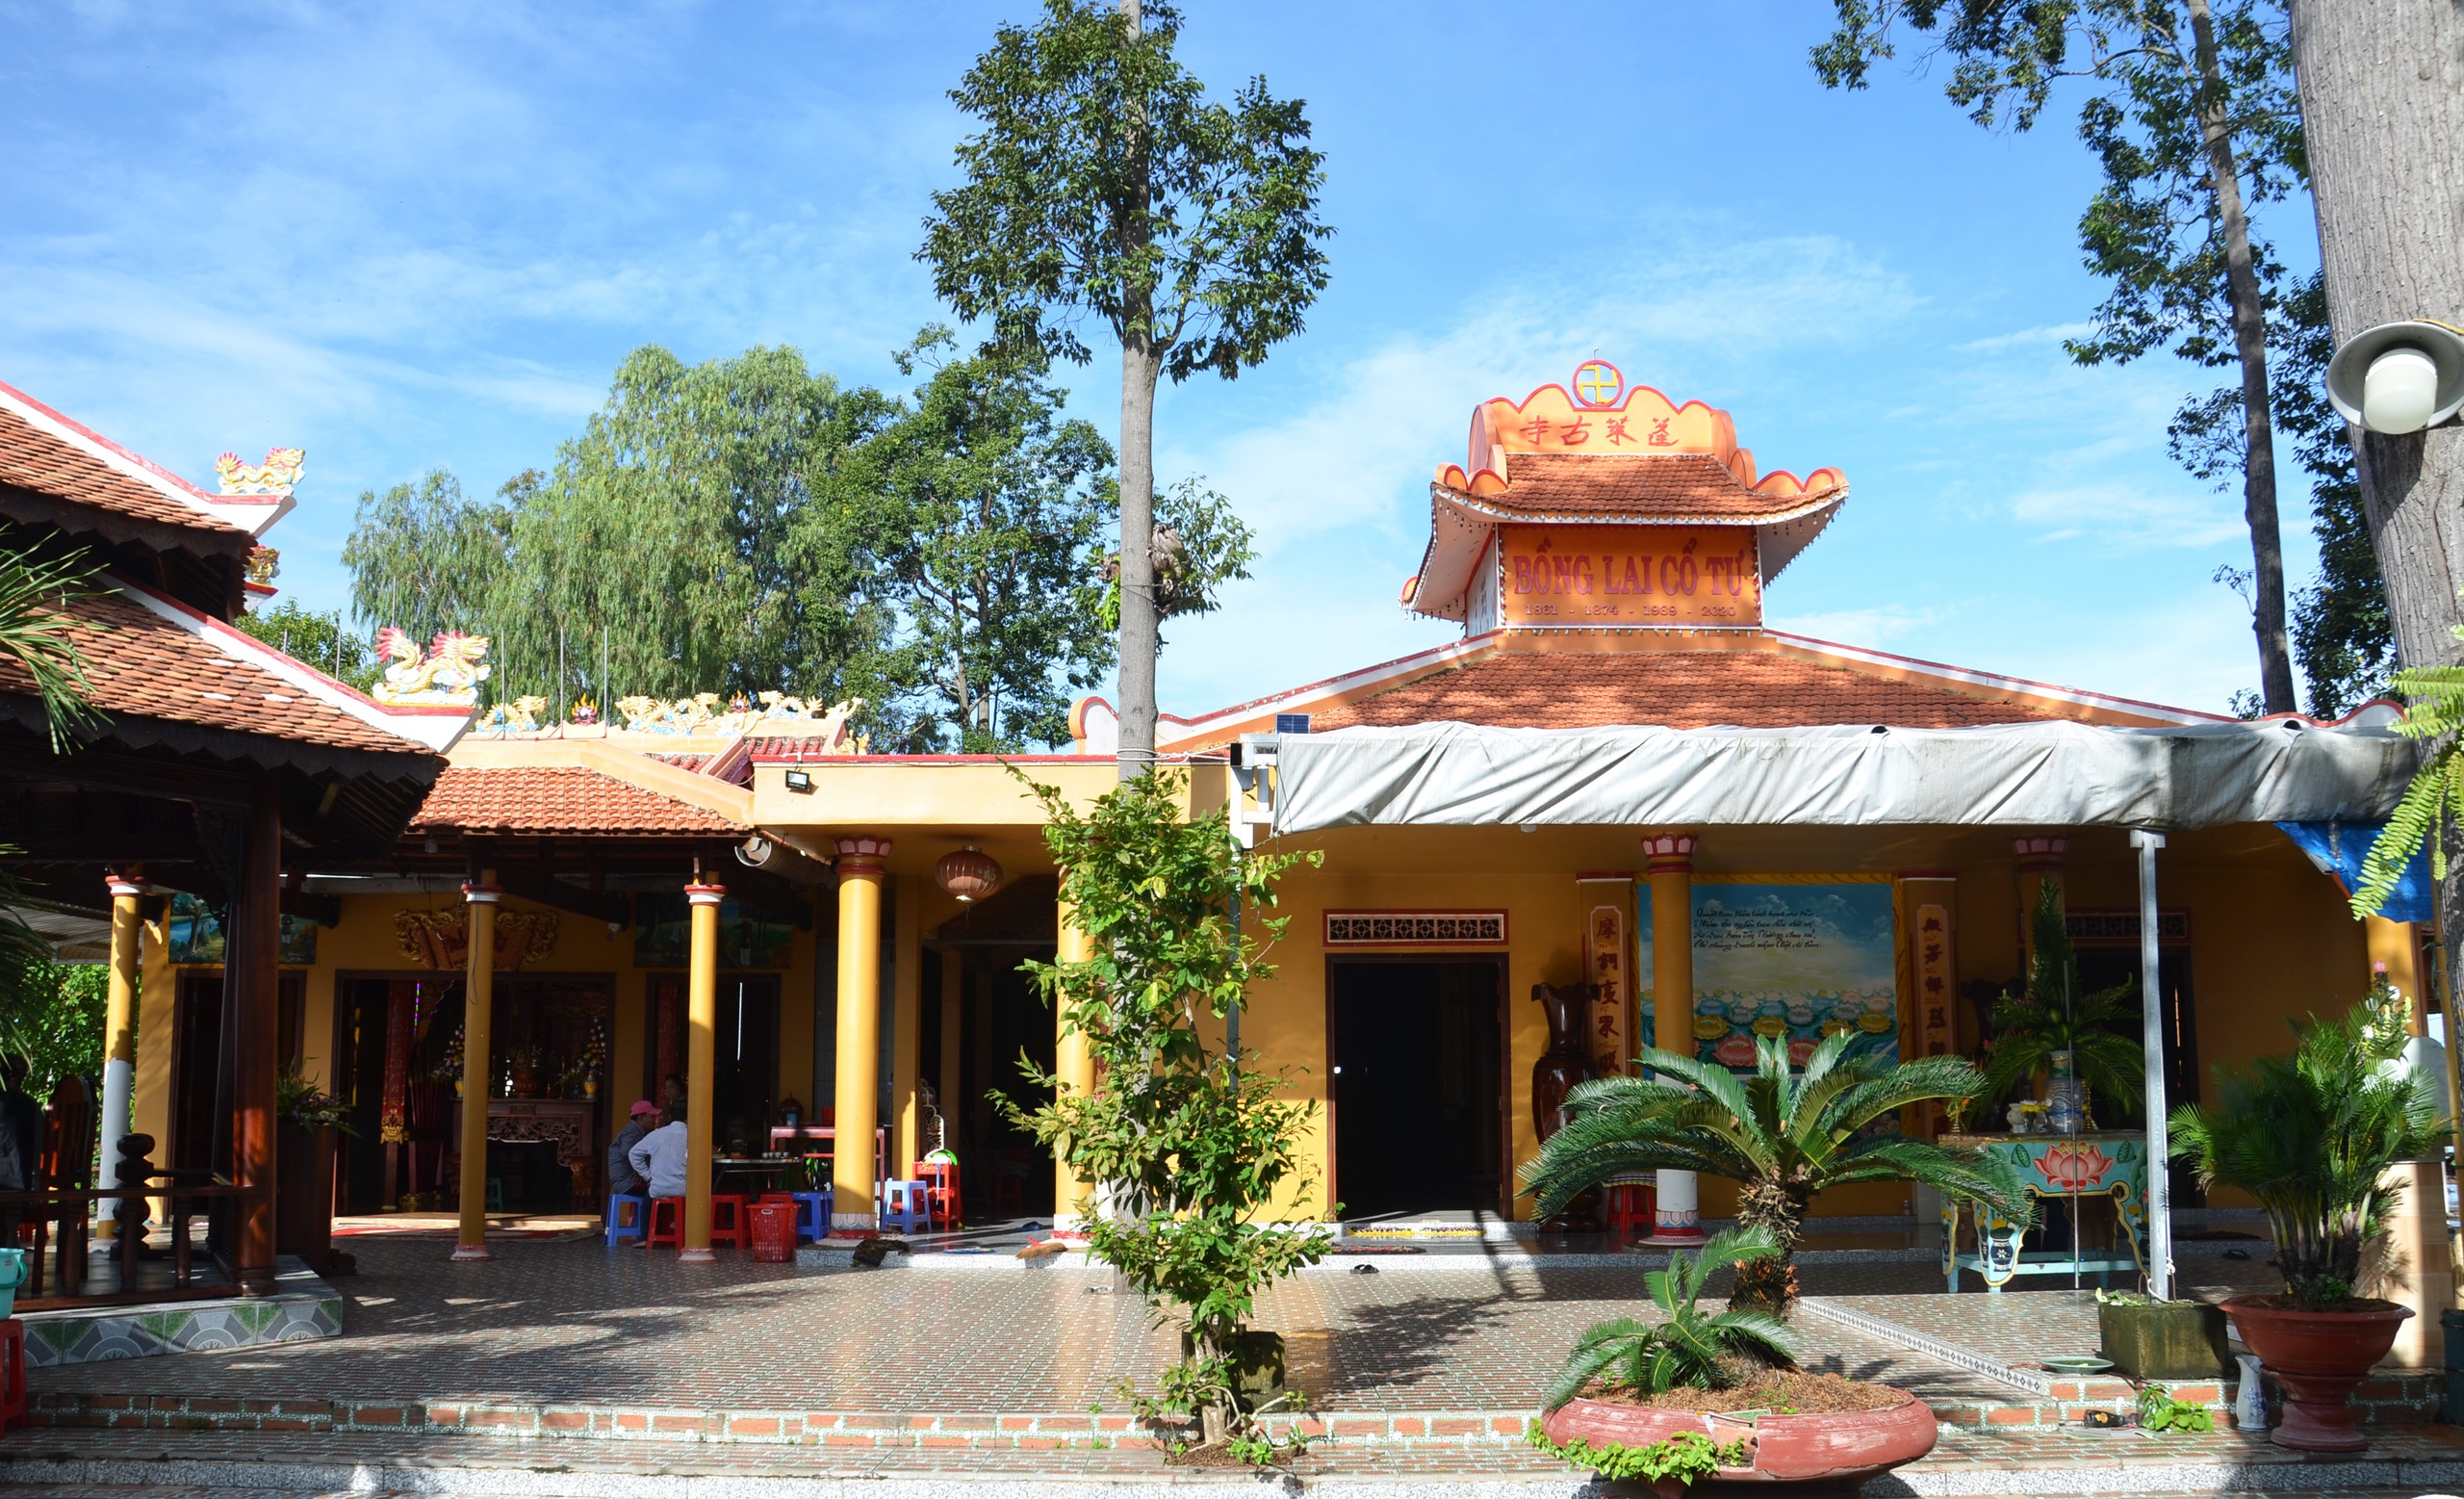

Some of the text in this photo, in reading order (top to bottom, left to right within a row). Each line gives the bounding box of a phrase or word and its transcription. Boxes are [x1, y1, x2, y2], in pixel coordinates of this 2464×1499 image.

[1513, 537, 1745, 603] BỒNG LAI CỔ TỰ
[1526, 605, 1558, 615] 1861
[1585, 605, 1619, 615] 1874
[1702, 606, 1736, 616] 2020
